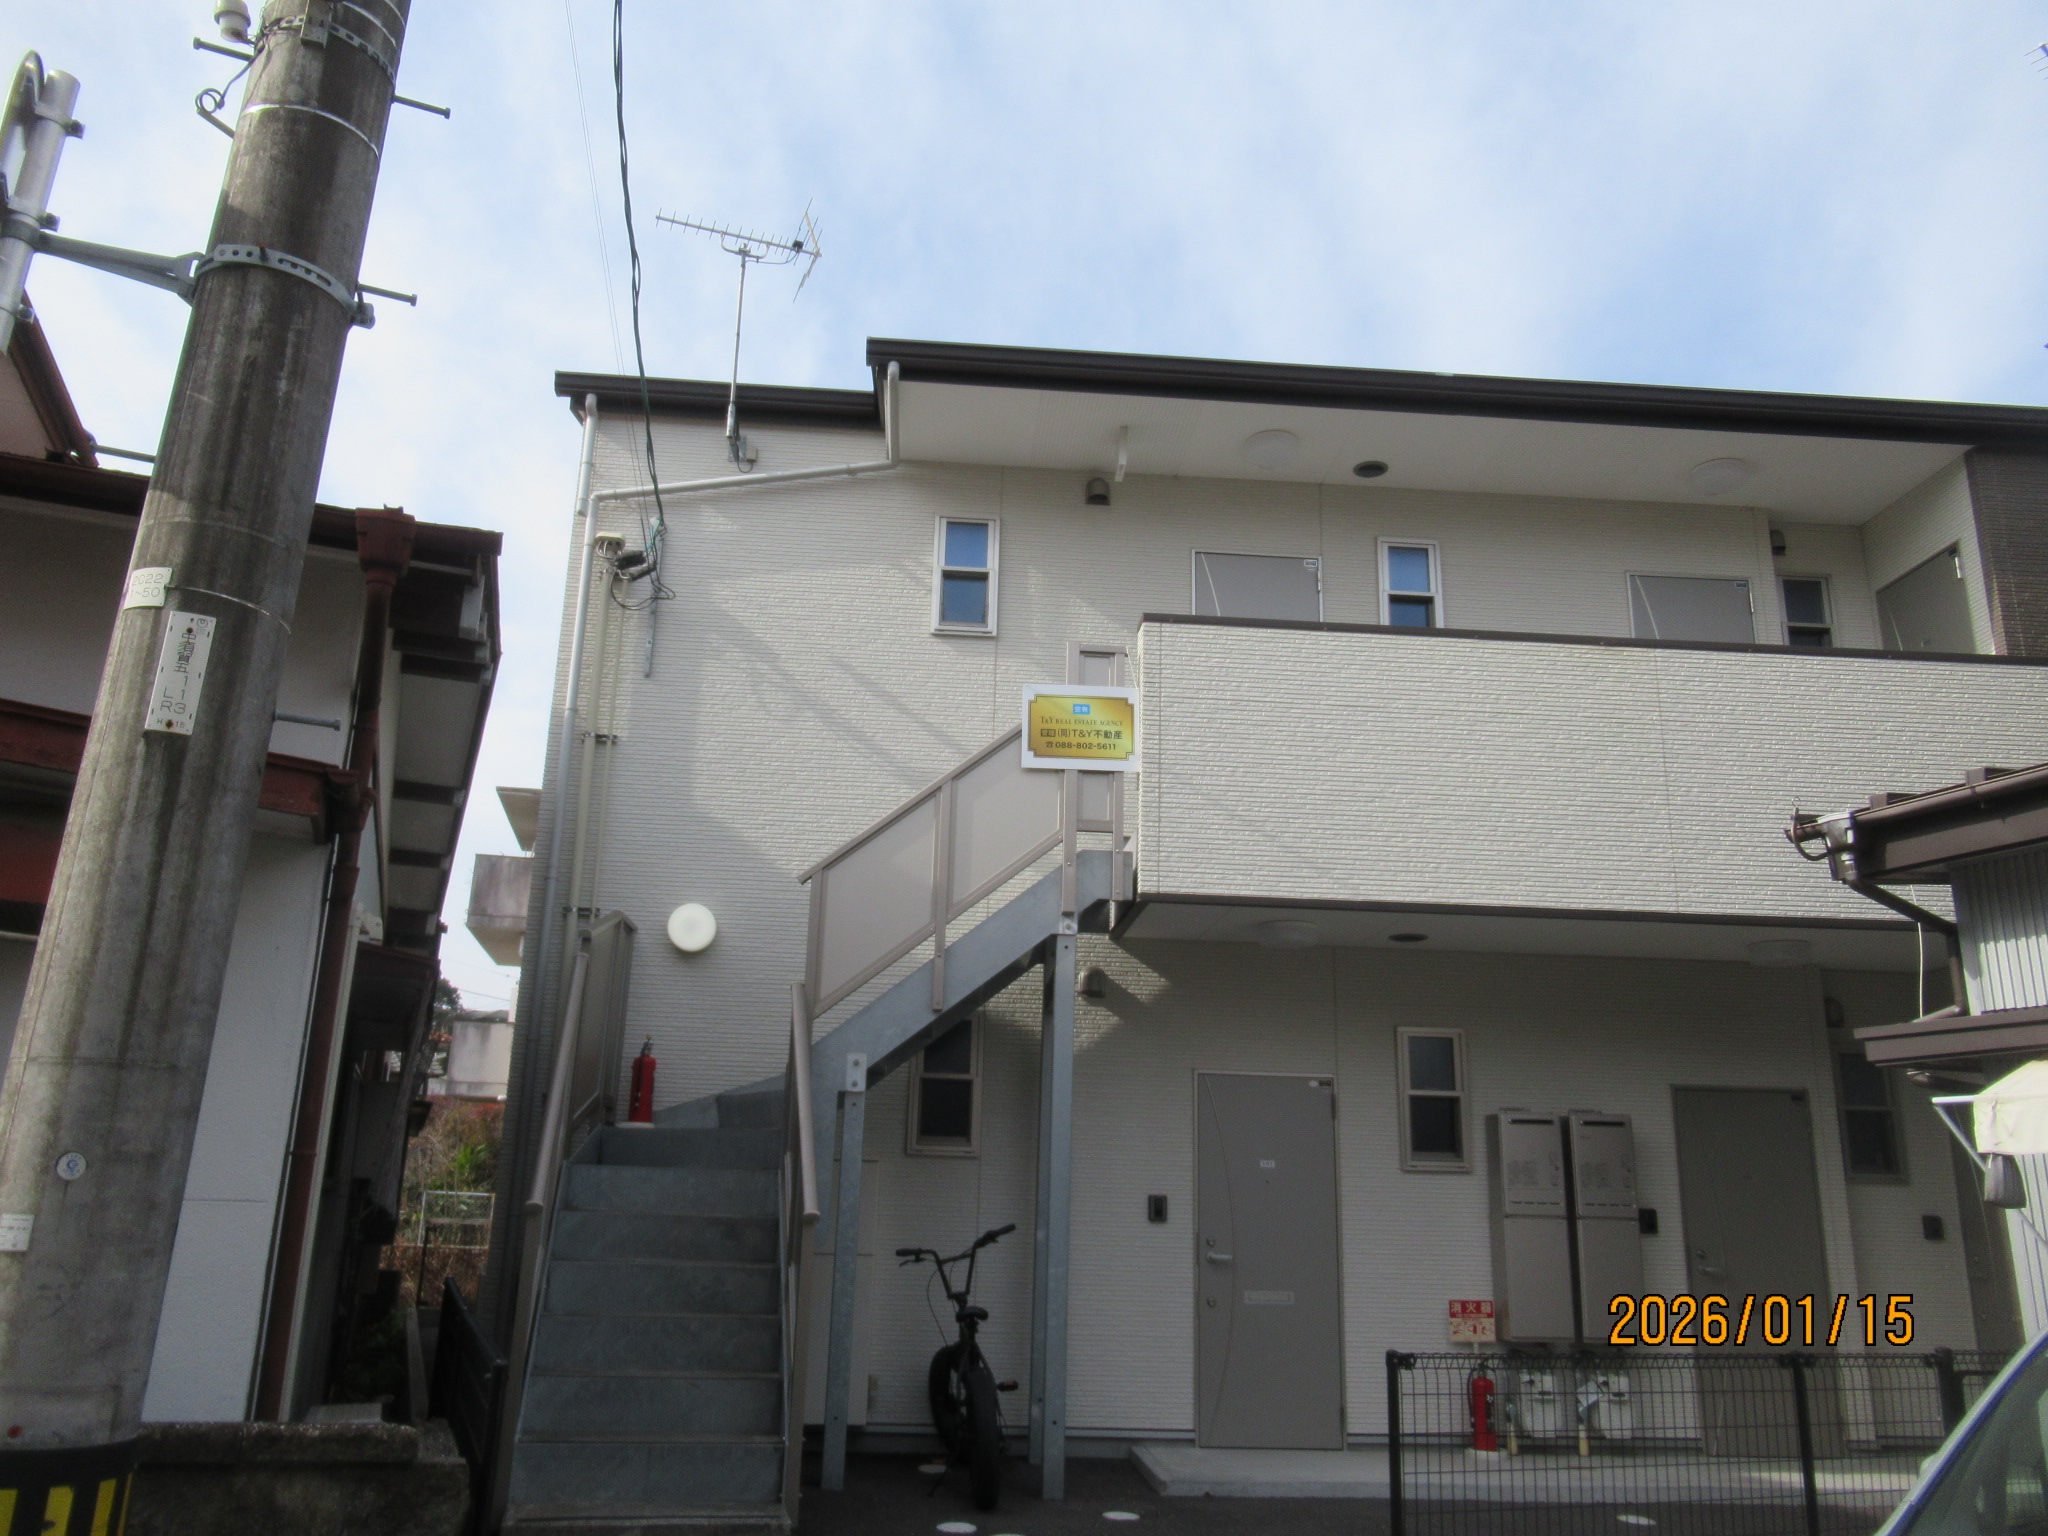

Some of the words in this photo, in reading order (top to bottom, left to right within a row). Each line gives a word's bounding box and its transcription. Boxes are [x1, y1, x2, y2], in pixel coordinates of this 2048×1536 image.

[131, 573, 164, 586] 2022
[1040, 716, 1055, 724] T&Y
[1055, 741, 1116, 750] 088-802-5611
